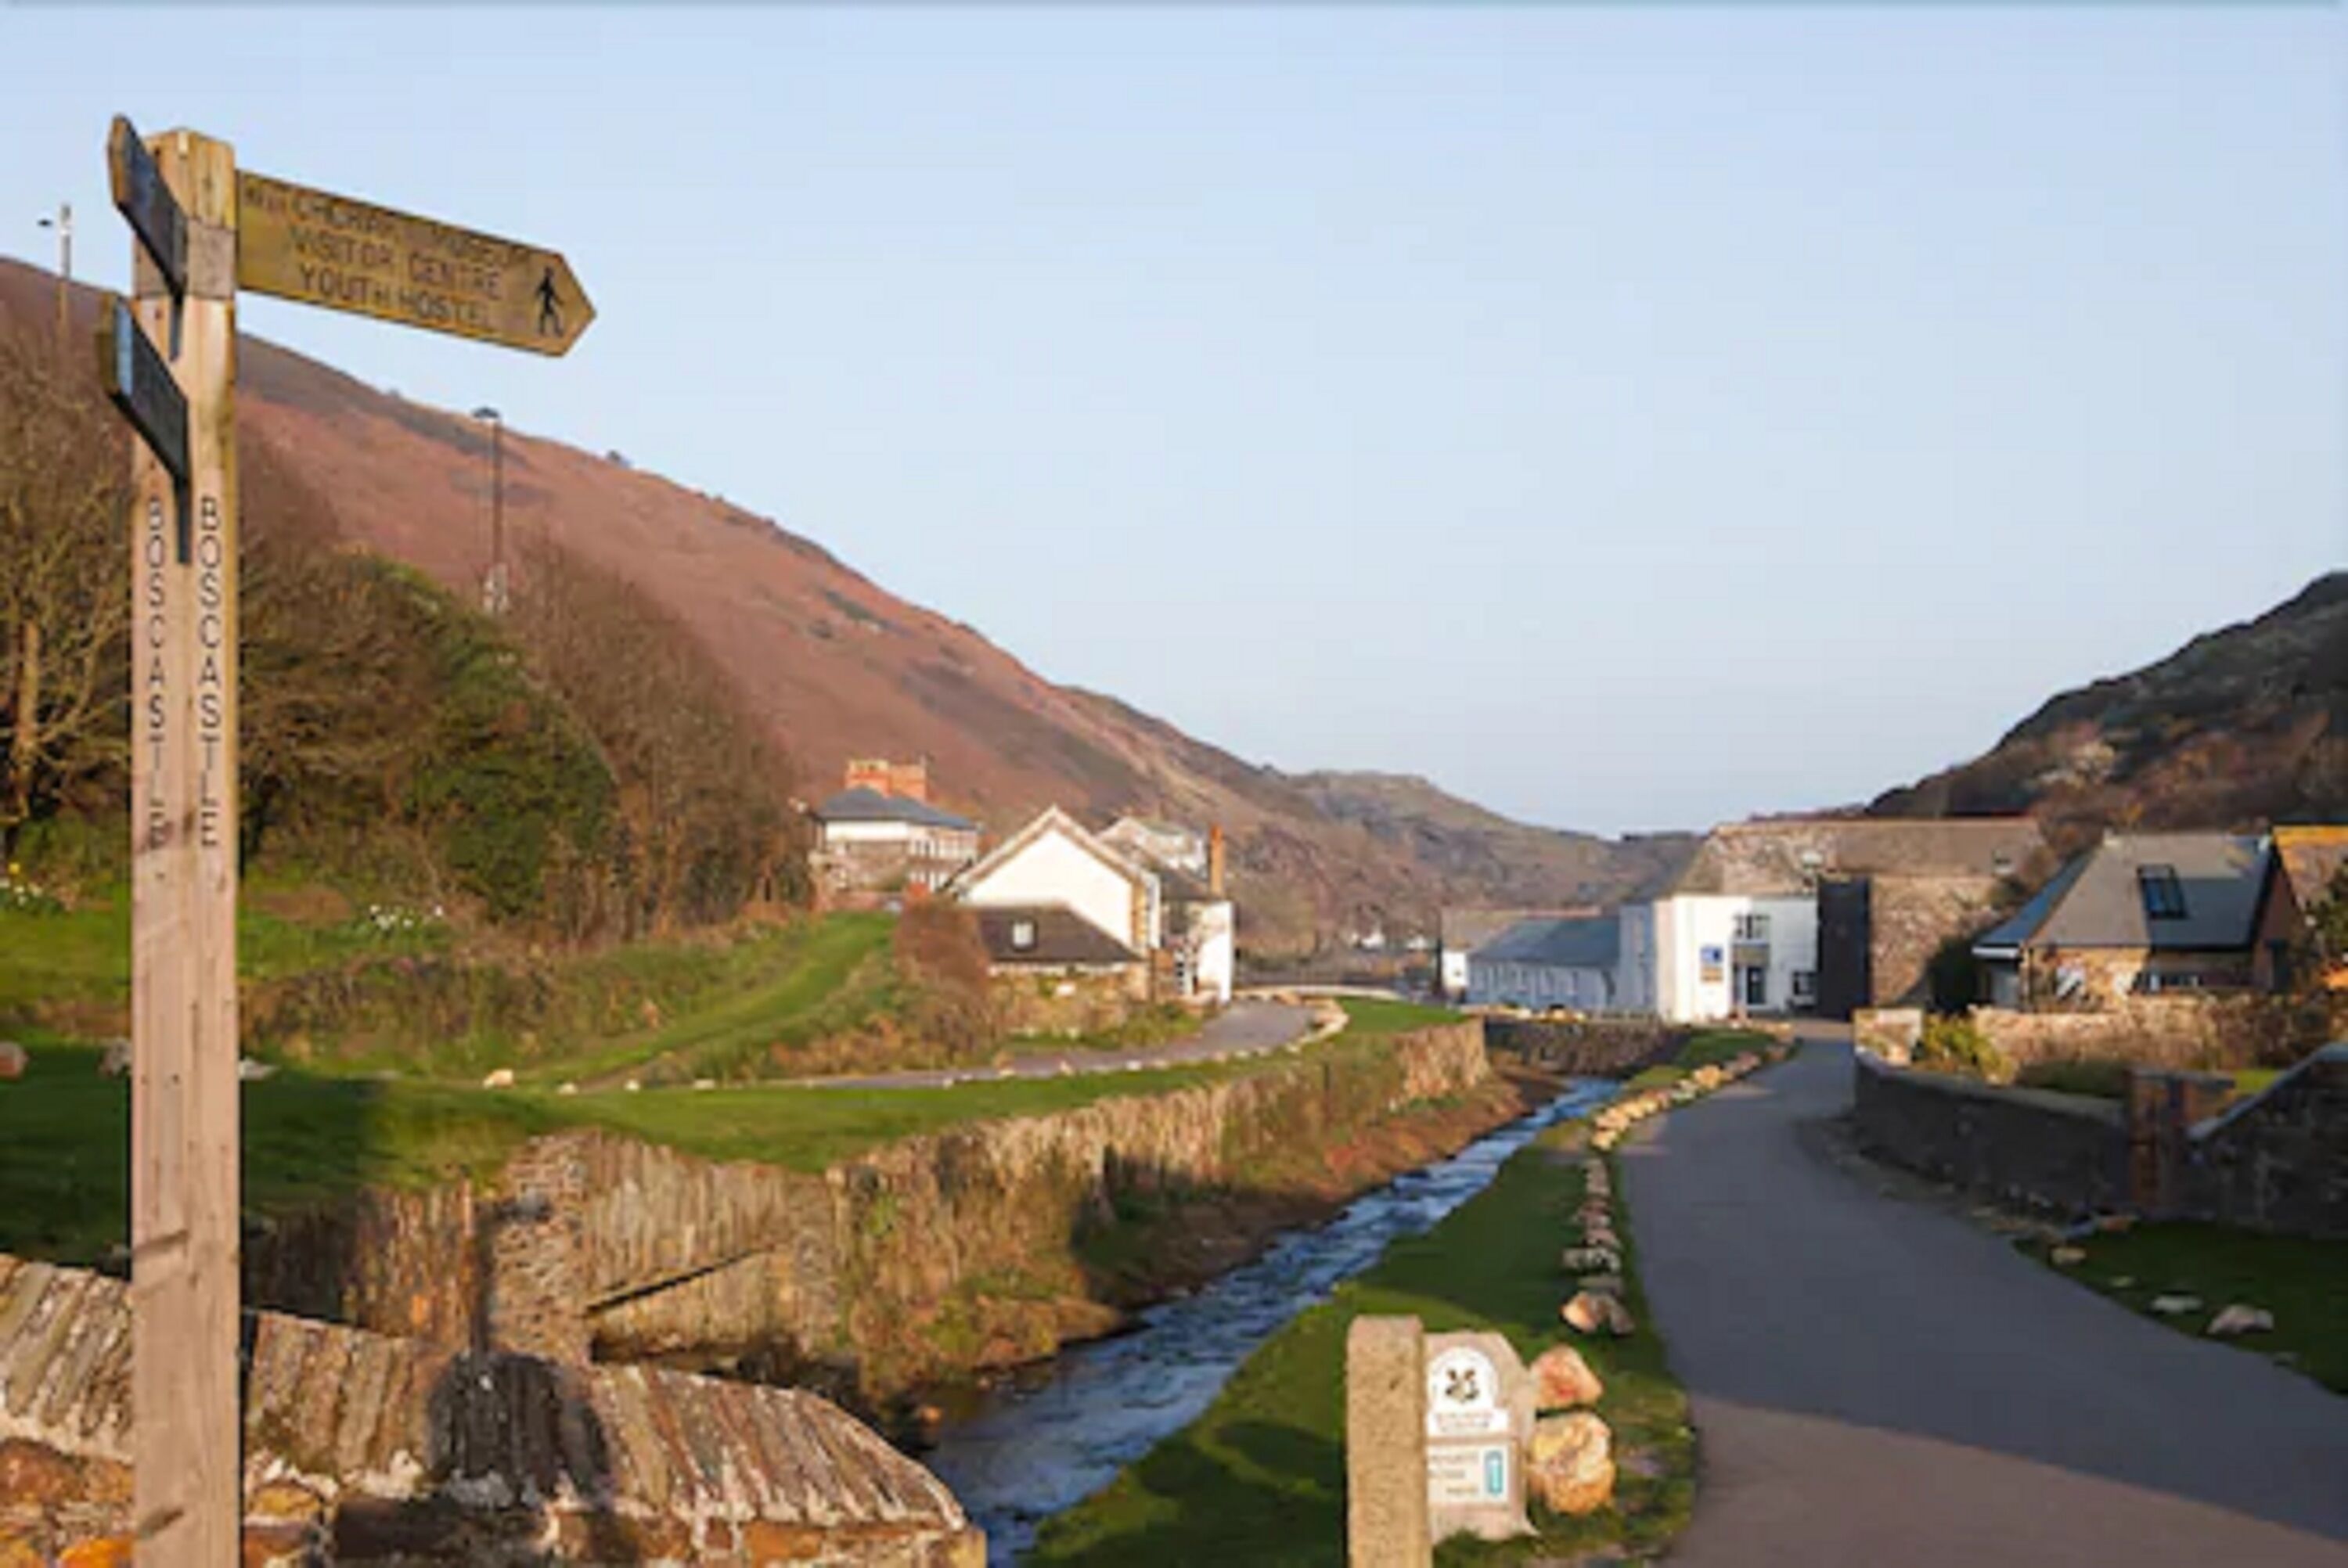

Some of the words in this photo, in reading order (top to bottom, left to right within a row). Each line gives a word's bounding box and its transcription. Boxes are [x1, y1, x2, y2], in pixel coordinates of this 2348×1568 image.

[290, 228, 391, 268] VISITOR
[409, 250, 502, 299] CENTRE
[297, 264, 386, 307] YOUTH
[399, 288, 491, 328] HOSTEL
[146, 496, 165, 849] BOSCASTLE
[200, 496, 221, 847] BOSCASTLE
